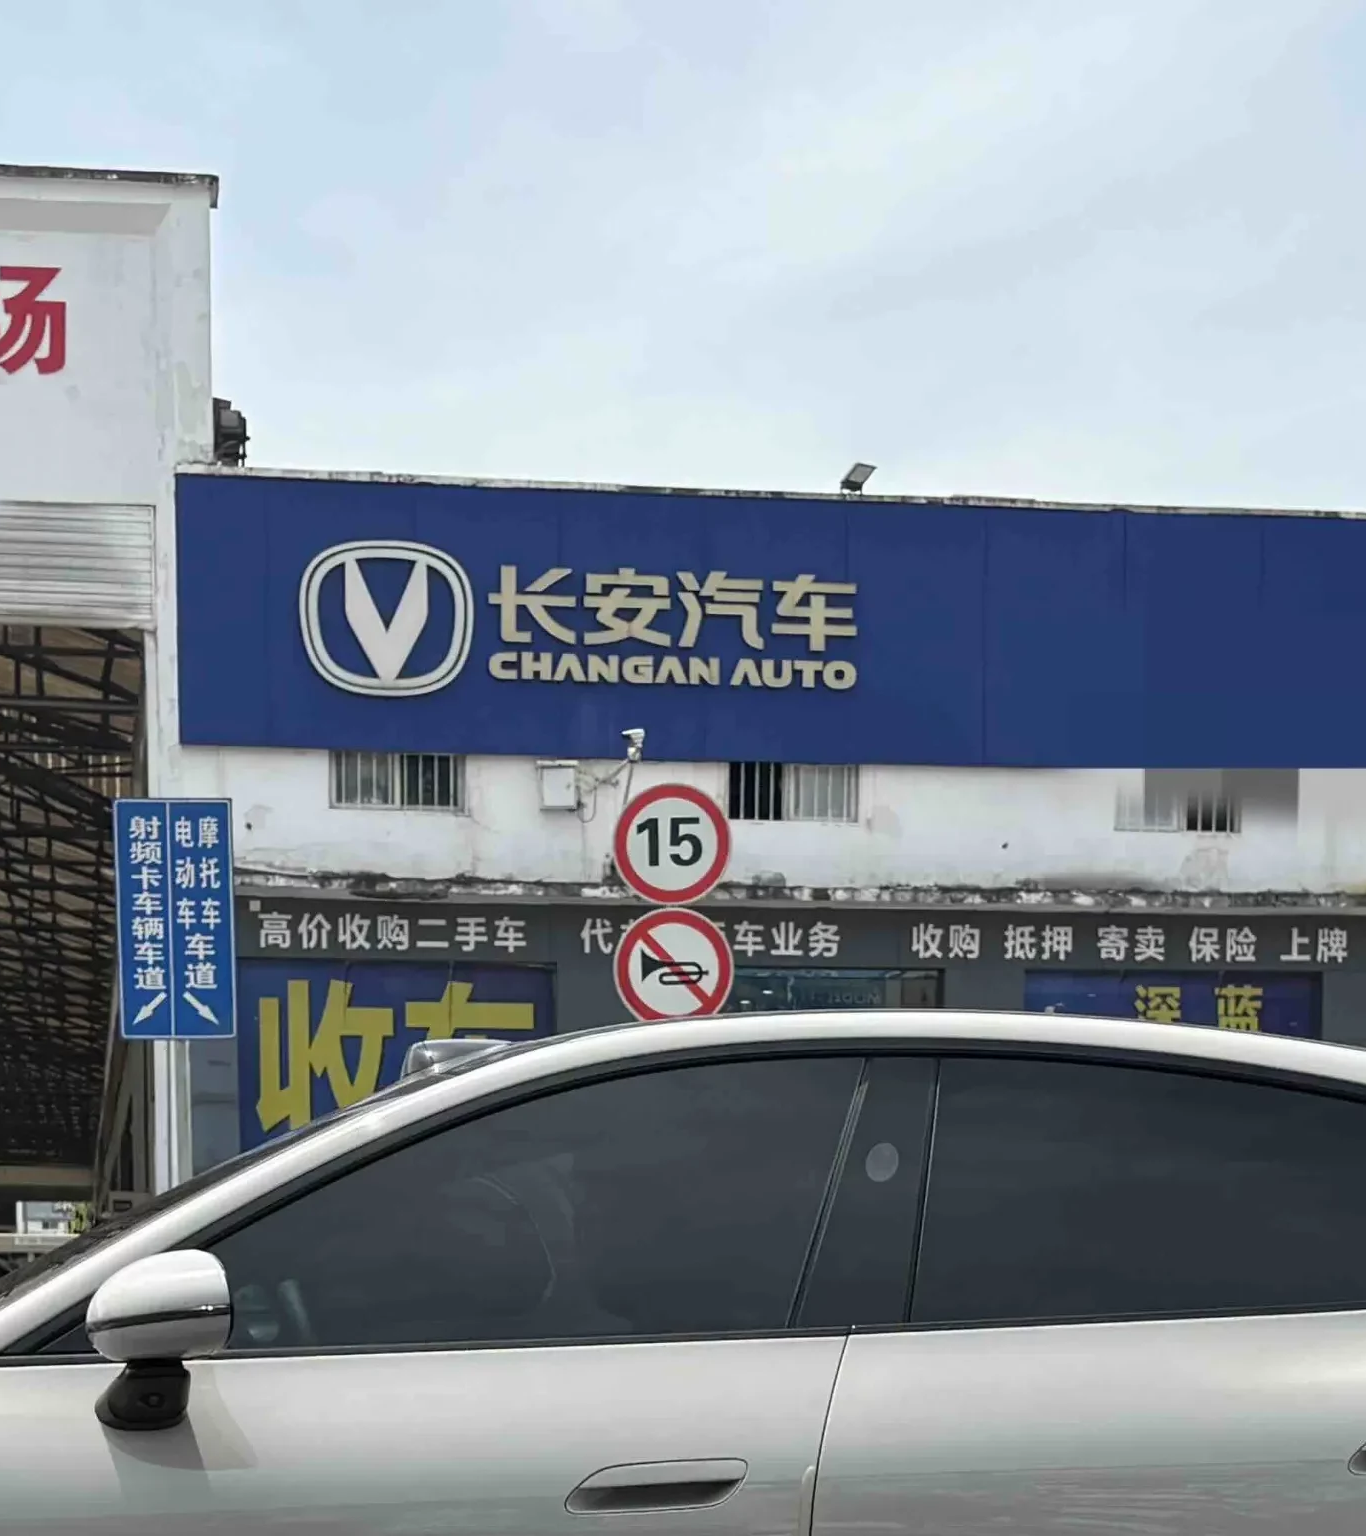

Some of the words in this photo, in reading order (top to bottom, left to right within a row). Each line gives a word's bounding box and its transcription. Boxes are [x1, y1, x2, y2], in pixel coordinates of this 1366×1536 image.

[488, 565, 857, 651] 长安汽车
[488, 652, 720, 685] CHANGAN
[730, 658, 857, 690] AUTO
[636, 817, 703, 868] 15
[175, 816, 197, 930] 电动车
[198, 816, 222, 930] 摩托车
[129, 816, 166, 989] 射频卡车辆车道
[258, 911, 527, 953] 高价收购二手车
[580, 918, 841, 958] 代车业务
[912, 924, 980, 959] 收购
[1003, 925, 1073, 961] 抵押
[1096, 926, 1165, 961] 寄卖
[1189, 927, 1257, 963] 保险
[1280, 928, 1348, 963] 上牌
[185, 933, 218, 989] 车道
